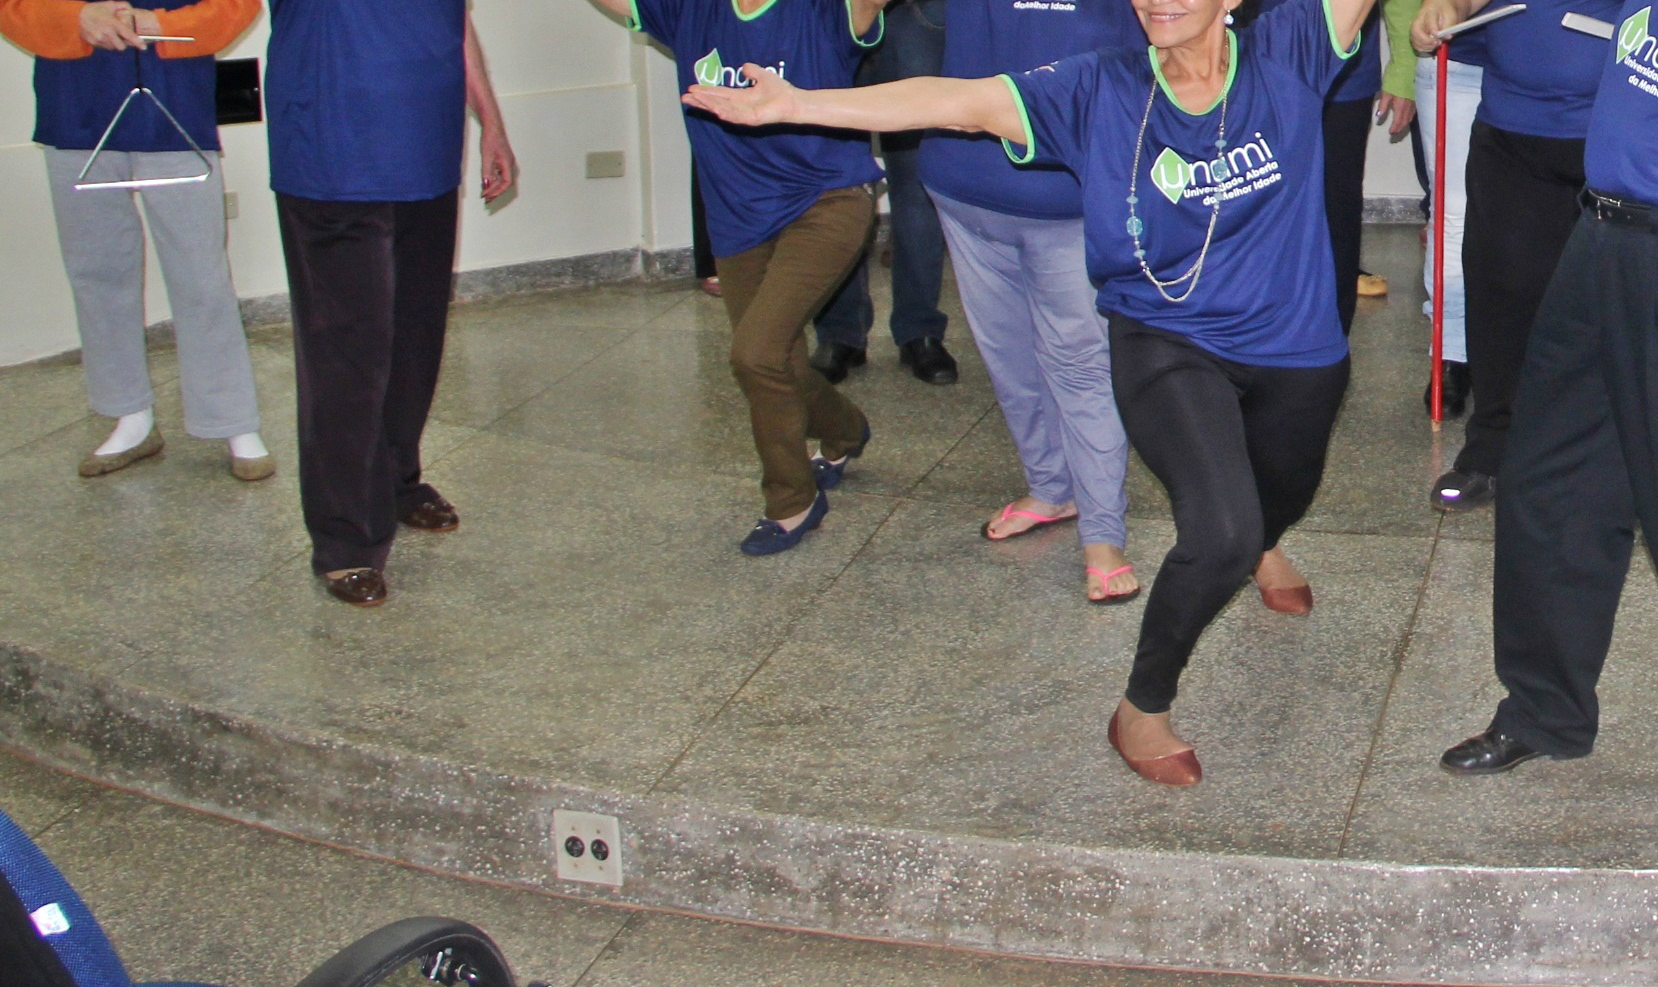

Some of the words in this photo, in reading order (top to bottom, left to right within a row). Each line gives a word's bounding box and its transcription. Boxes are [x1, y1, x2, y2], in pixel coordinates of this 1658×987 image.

[1050, 2, 1076, 11] Idade
[1628, 74, 1640, 87] da
[1245, 161, 1279, 181] Aberta
[1252, 172, 1282, 191] Idade
